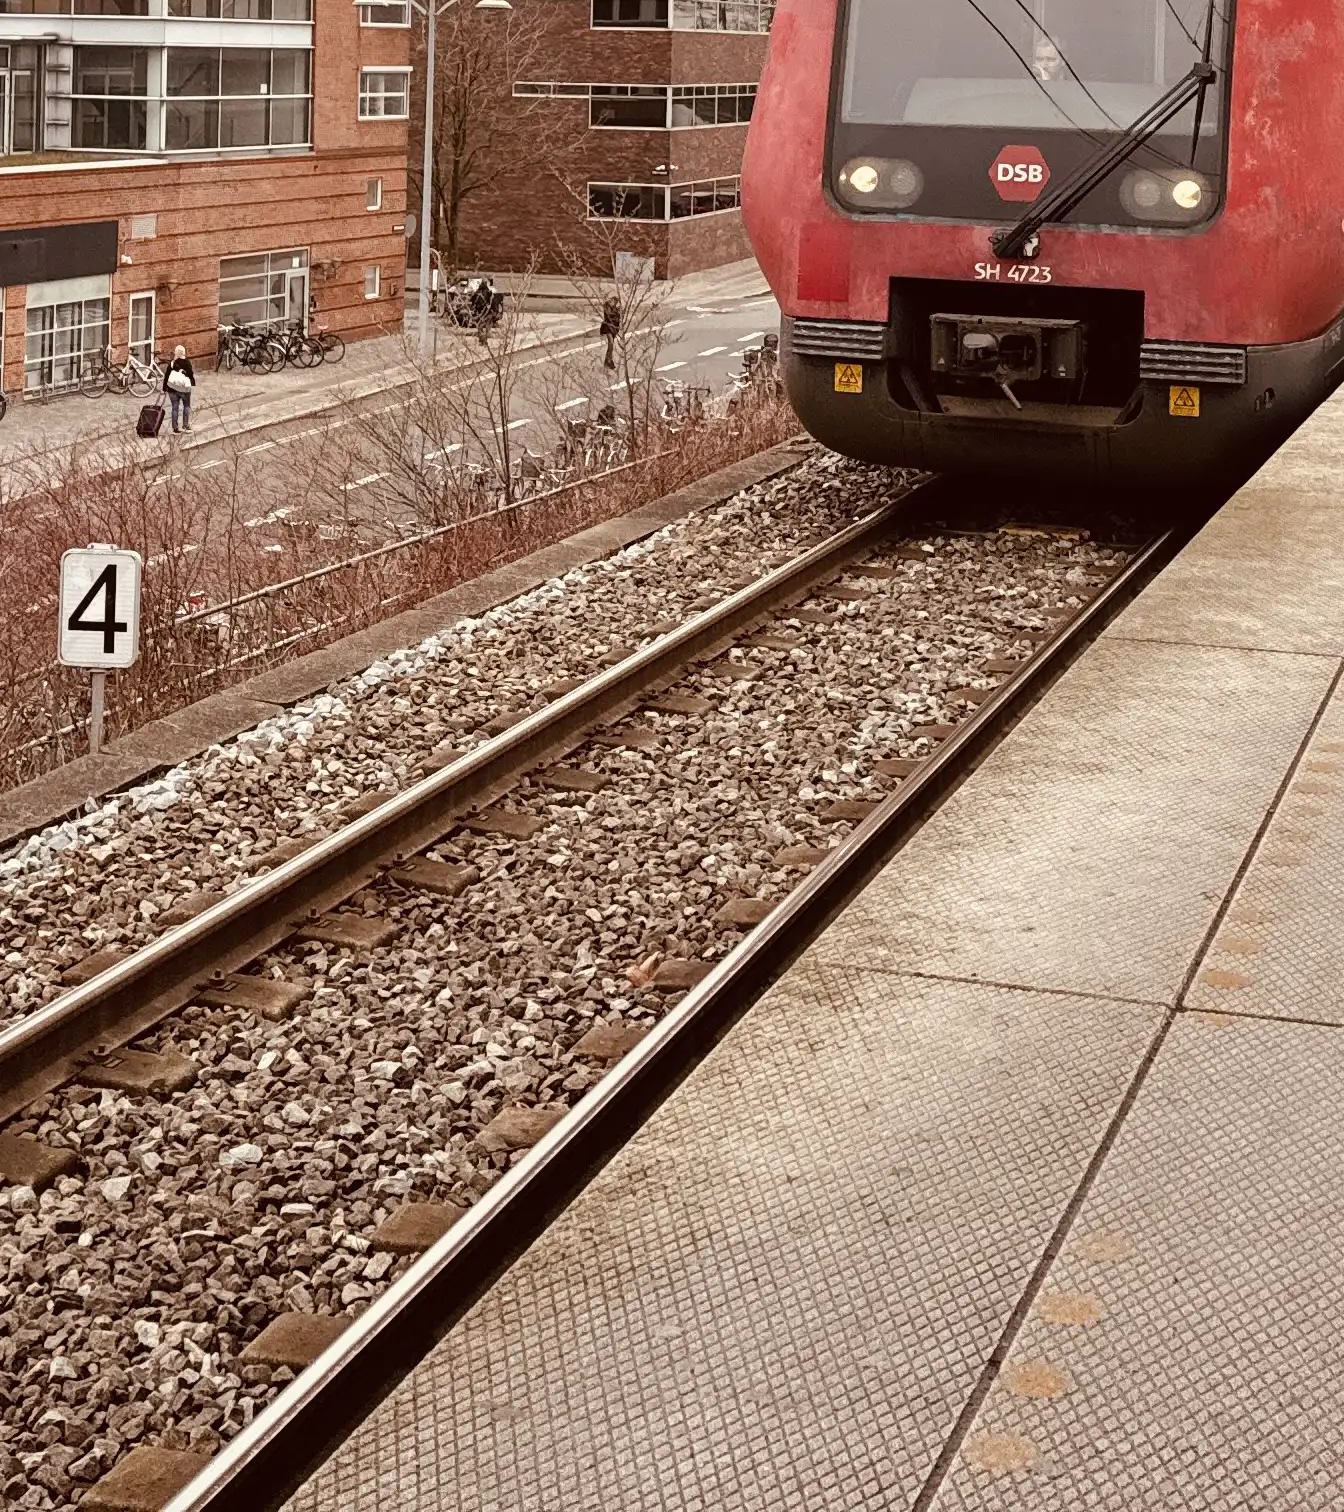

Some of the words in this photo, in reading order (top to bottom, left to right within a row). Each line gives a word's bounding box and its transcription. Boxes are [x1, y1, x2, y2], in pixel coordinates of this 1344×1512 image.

[997, 163, 1043, 183] DSB
[974, 262, 1001, 280] SH
[1007, 264, 1052, 283] 4723
[67, 563, 128, 654] 4
